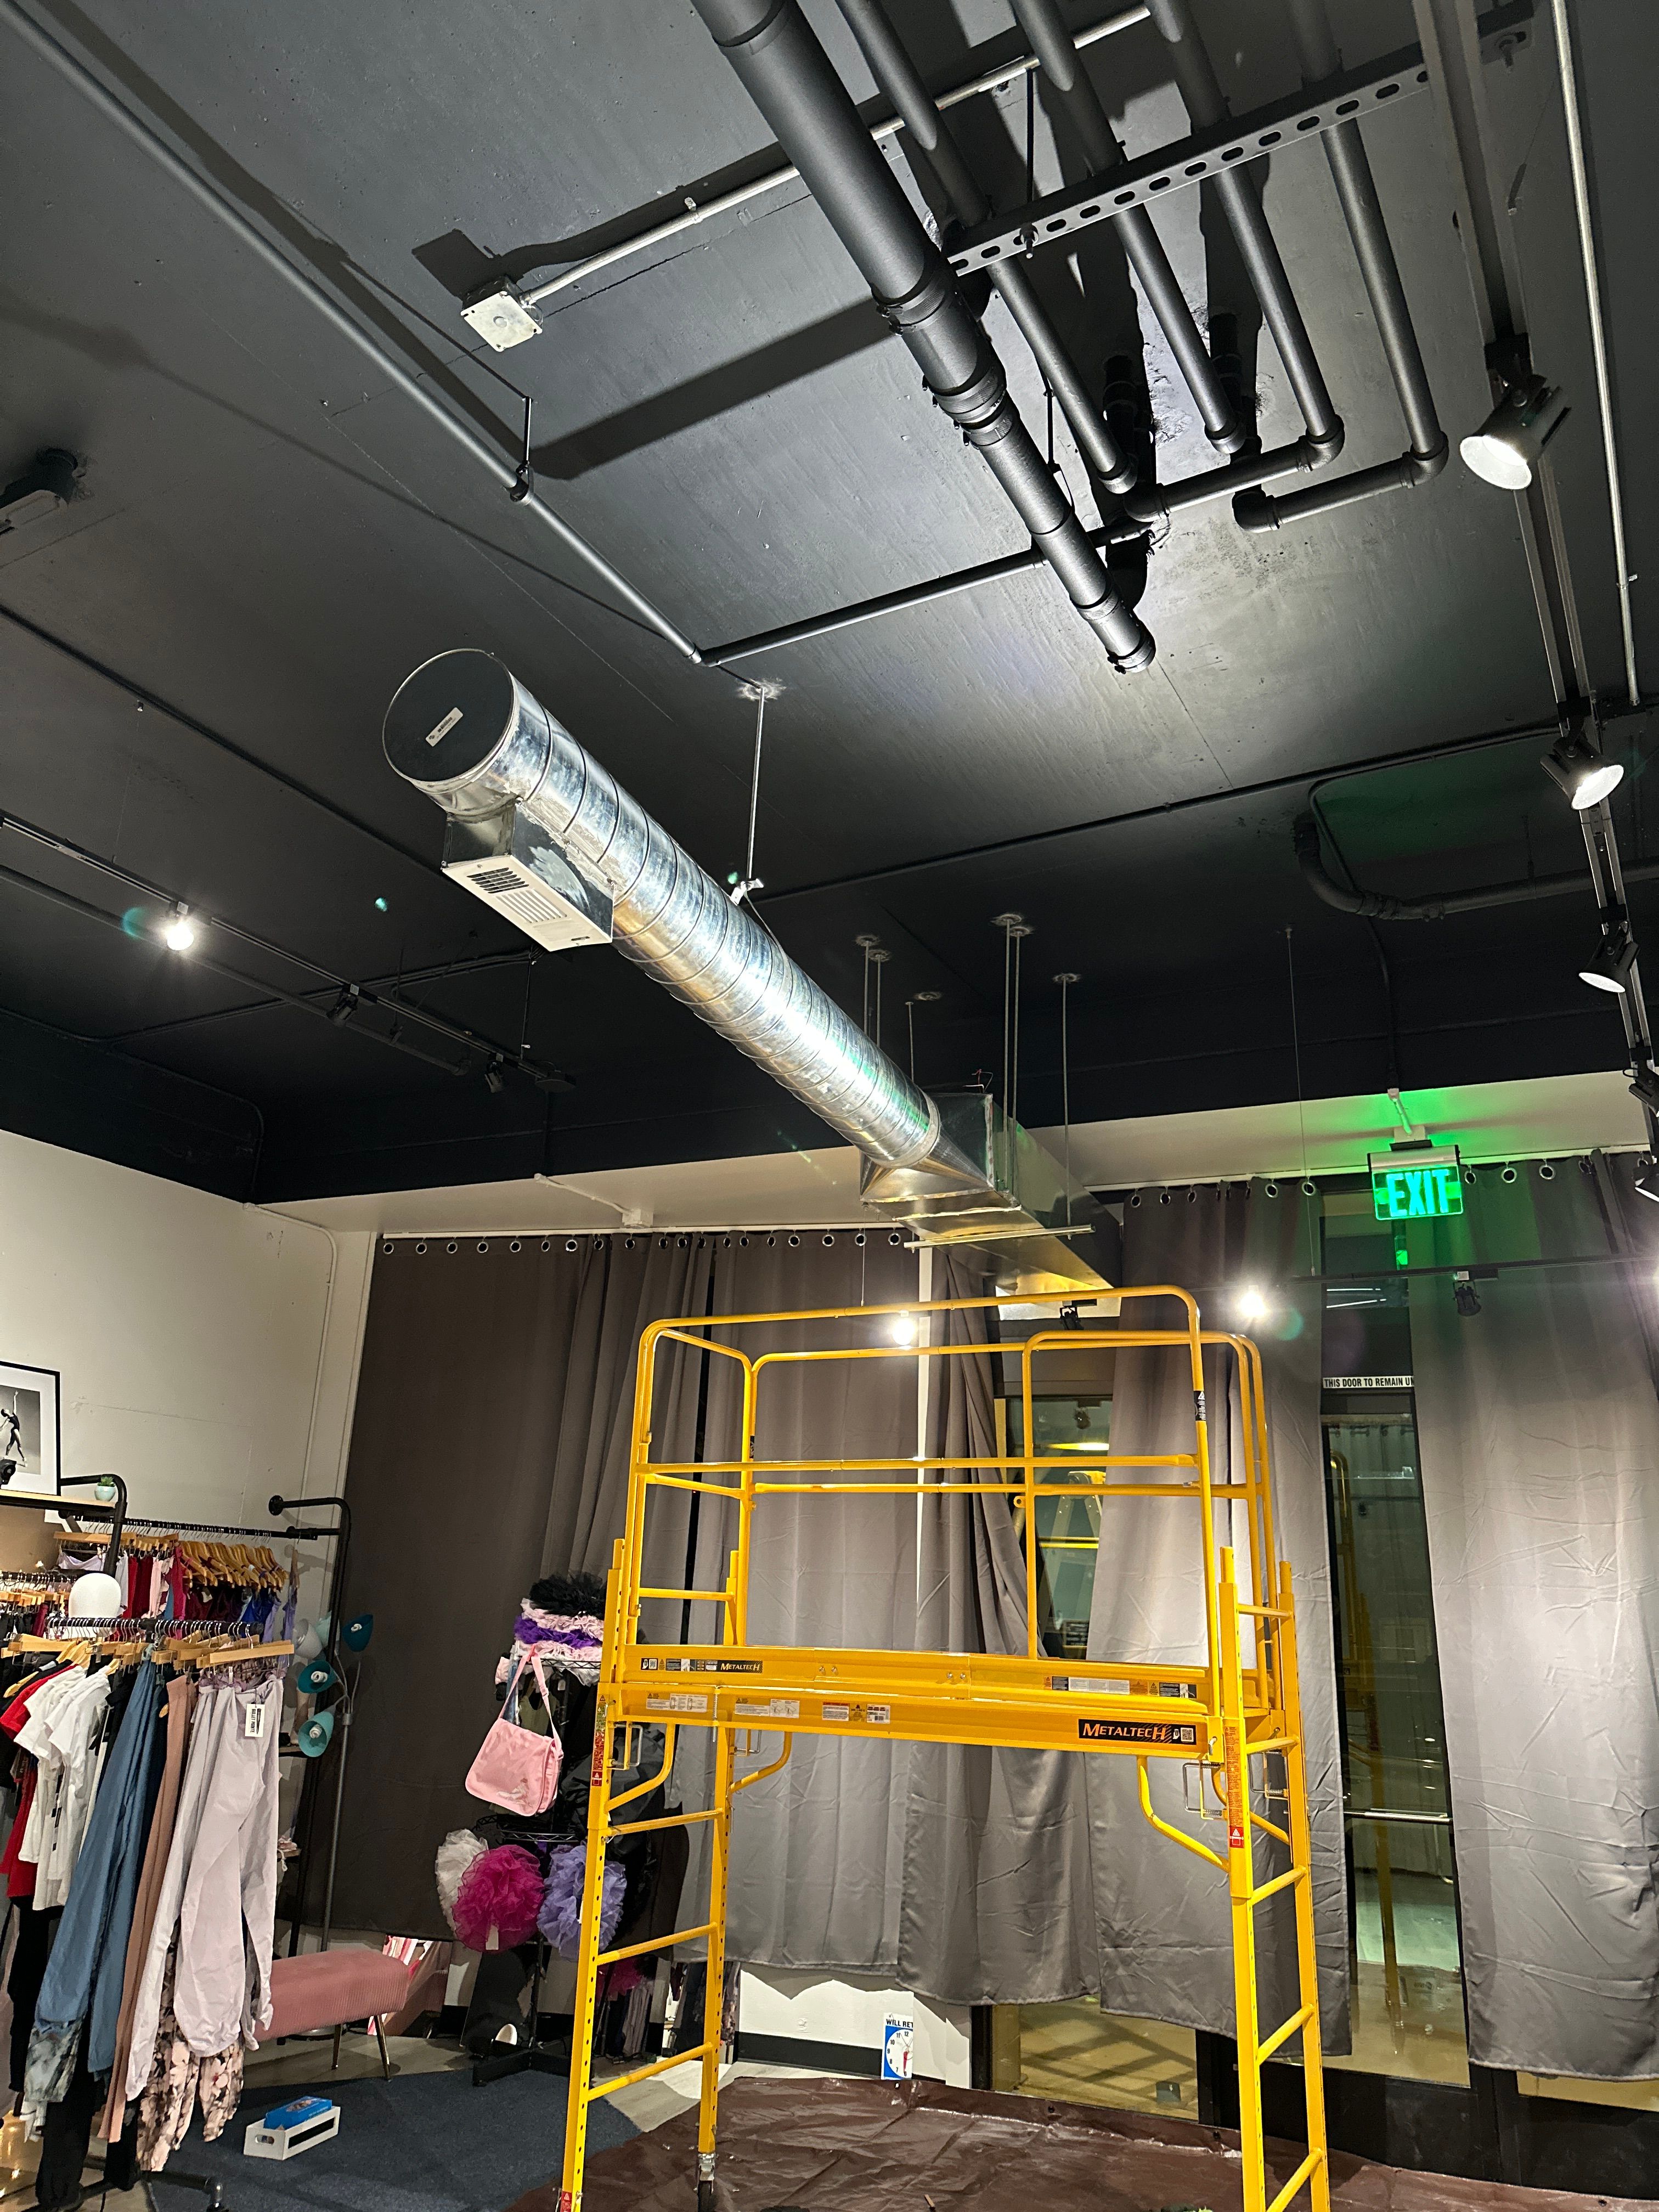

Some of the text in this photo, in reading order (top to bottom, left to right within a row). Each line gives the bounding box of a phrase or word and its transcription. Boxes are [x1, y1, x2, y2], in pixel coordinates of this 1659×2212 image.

[1386, 1169, 1451, 1217] EXIT
[1324, 1378, 1340, 1387] THIS
[1342, 1378, 1362, 1387] DOOR
[1364, 1378, 1373, 1387] TO
[1375, 1377, 1403, 1386] REMAIN
[720, 1662, 760, 1671] METALTECH
[1083, 1723, 1166, 1740] METALTECH
